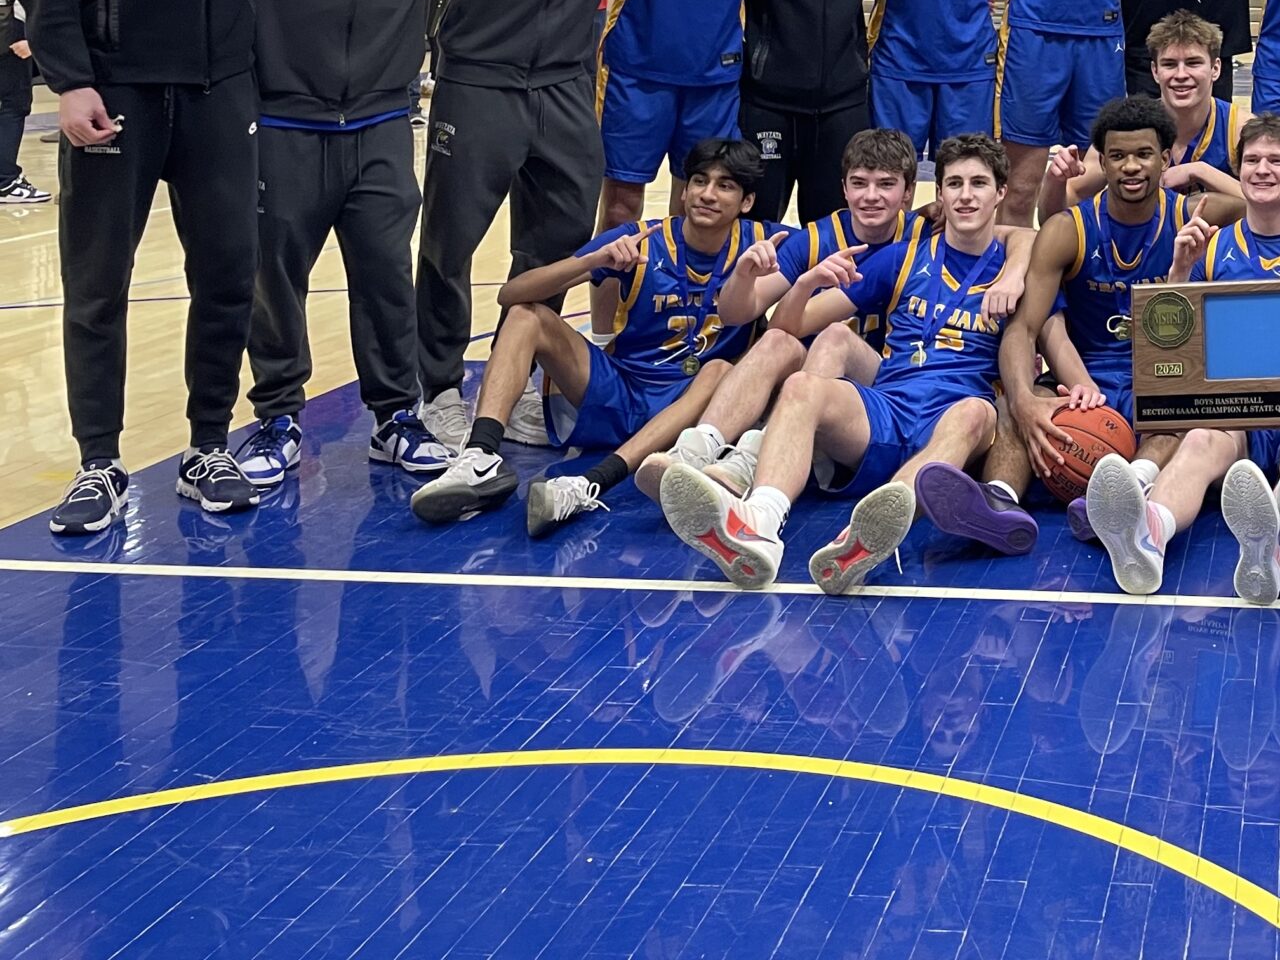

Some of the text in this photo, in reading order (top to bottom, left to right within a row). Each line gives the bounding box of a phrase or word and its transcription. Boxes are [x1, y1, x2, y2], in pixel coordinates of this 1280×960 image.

[756, 131, 782, 140] WAYZATA
[84, 145, 121, 154] BASKETBALL
[1158, 365, 1180, 375] 2026
[1194, 396, 1264, 406] BOYS BASKETBALL
[1142, 408, 1175, 416] SECTION
[1201, 406, 1241, 415] CHAMPION
[1242, 405, 1248, 413] &
[1249, 405, 1274, 413] STATE
